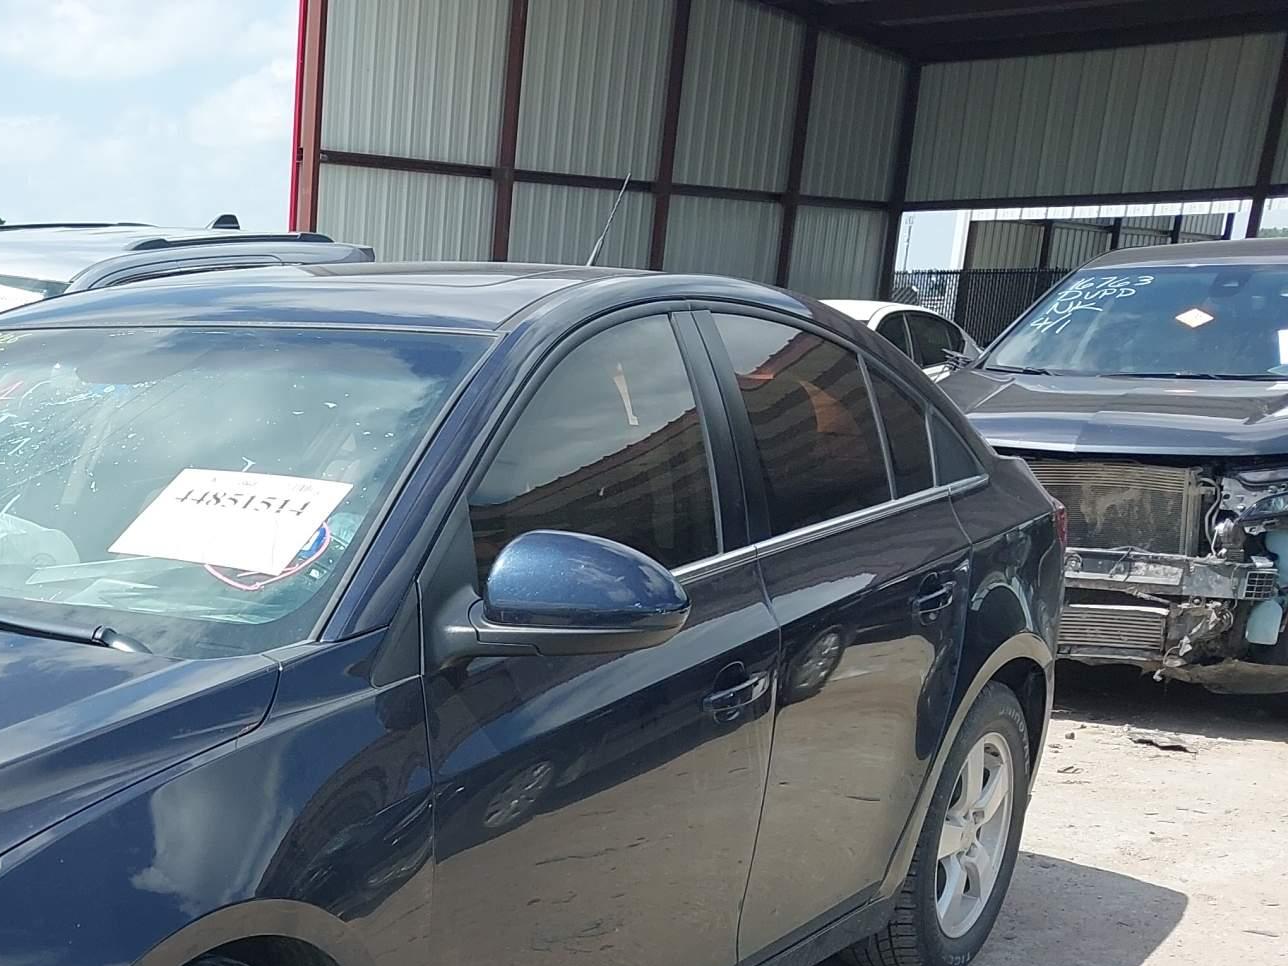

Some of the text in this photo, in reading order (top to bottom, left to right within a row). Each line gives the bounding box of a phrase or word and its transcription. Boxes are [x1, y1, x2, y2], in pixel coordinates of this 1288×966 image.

[1068, 275, 1155, 290] 16763
[1029, 312, 1072, 334] 4/1
[175, 488, 311, 517] 44851514
